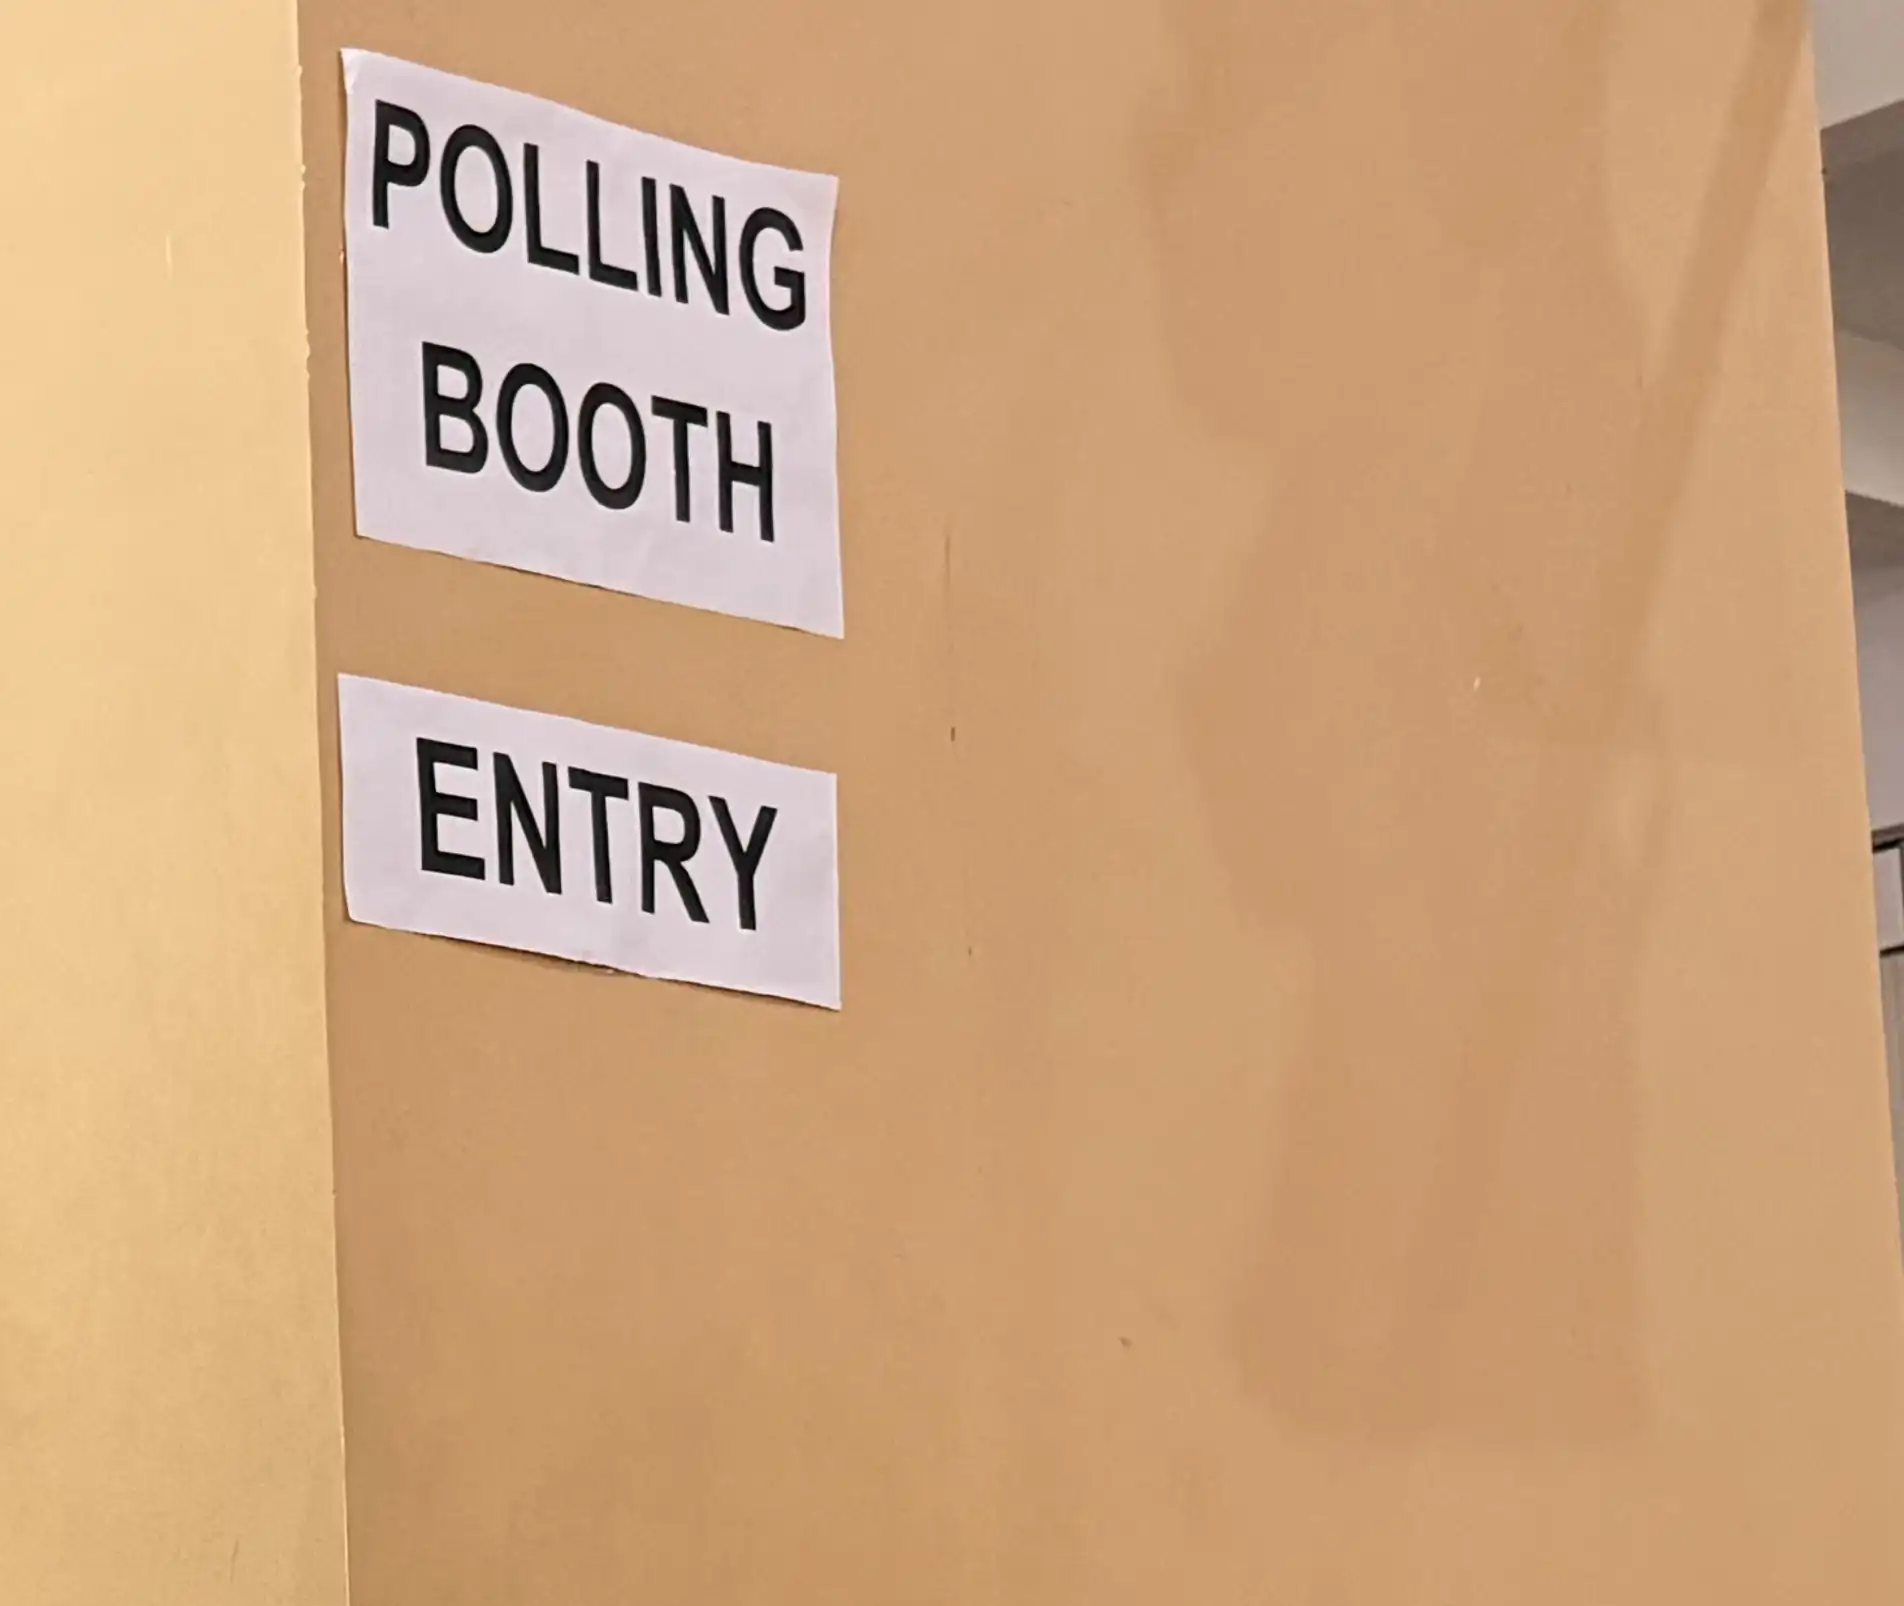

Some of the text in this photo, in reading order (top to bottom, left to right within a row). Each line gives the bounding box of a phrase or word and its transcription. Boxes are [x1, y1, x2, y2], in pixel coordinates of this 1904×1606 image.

[371, 98, 807, 332] POLLING
[421, 340, 775, 544] BOOTH
[415, 736, 779, 932] ENTRY
